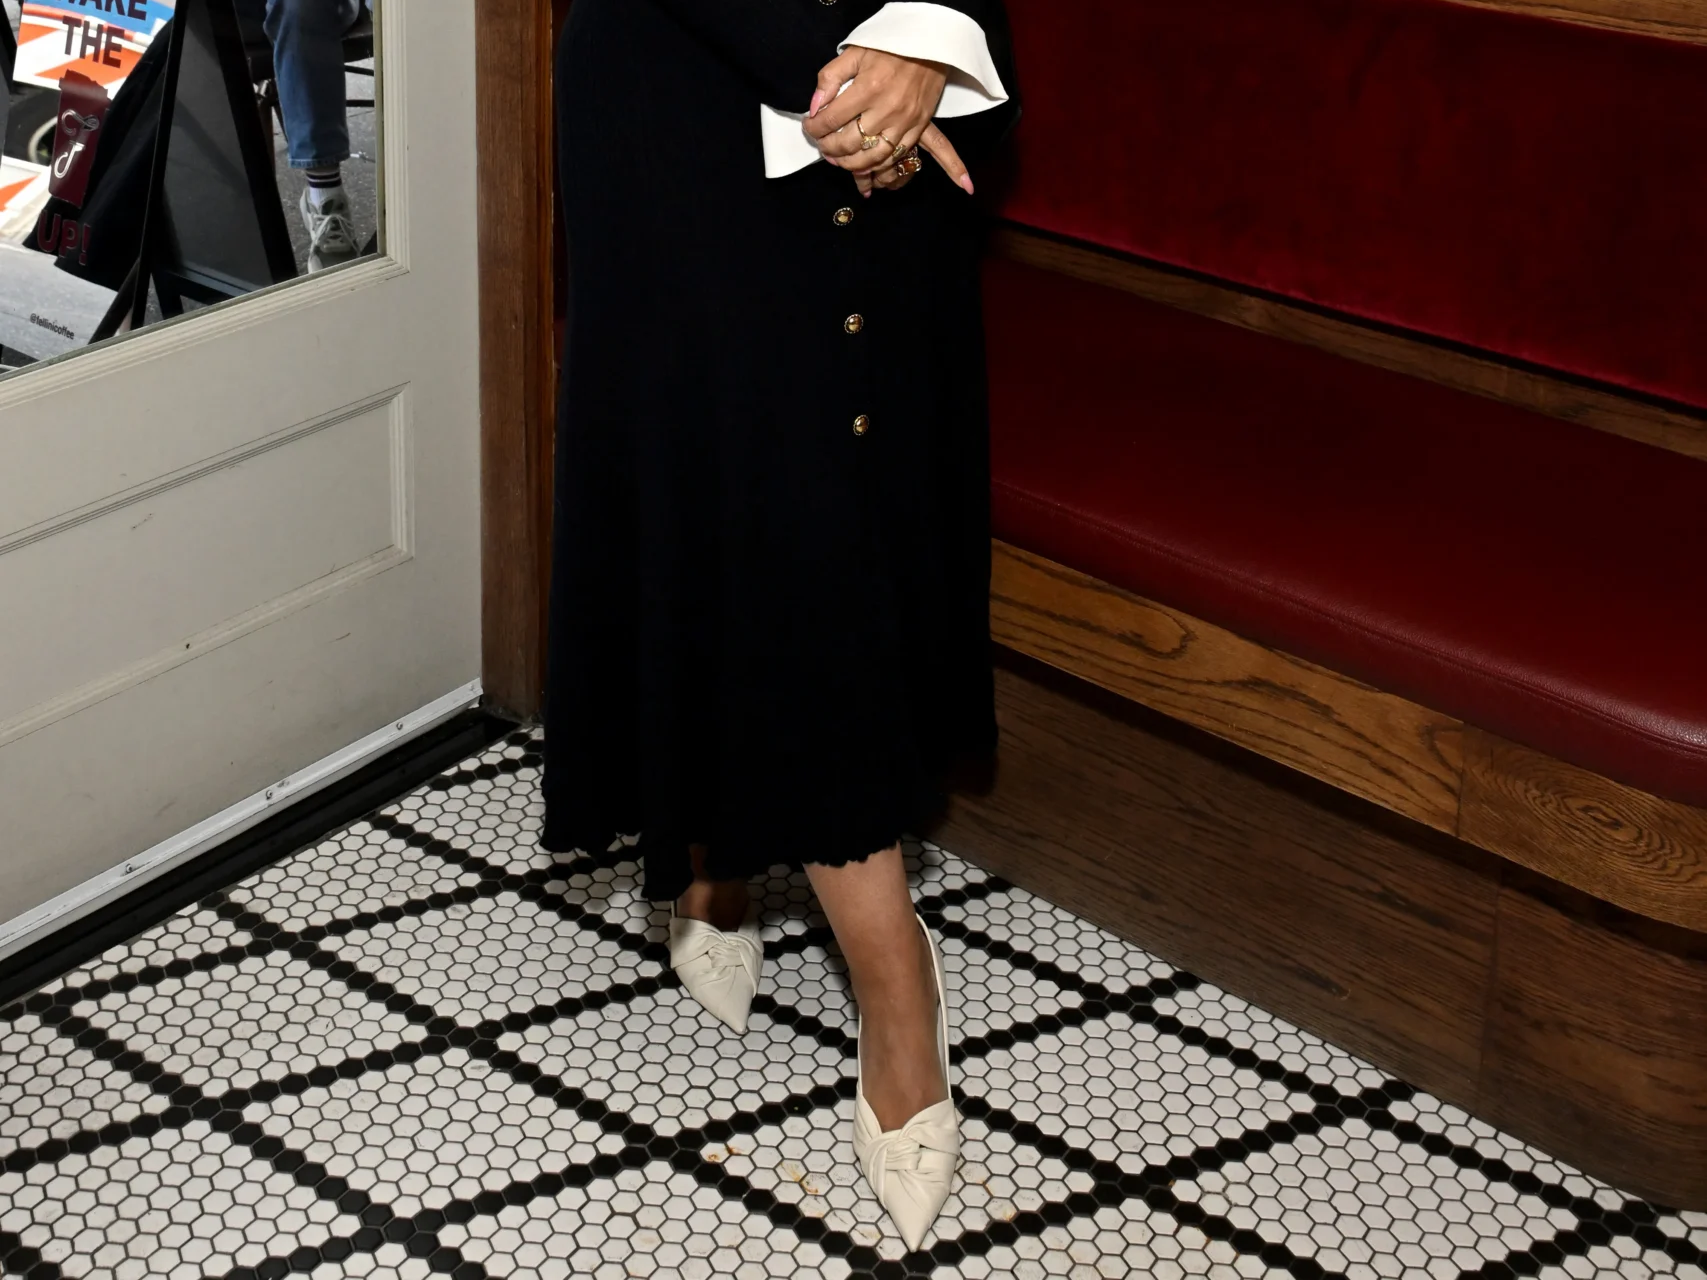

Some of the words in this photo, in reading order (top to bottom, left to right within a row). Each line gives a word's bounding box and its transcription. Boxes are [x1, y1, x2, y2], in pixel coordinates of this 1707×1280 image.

[62, 15, 126, 69] THE
[36, 208, 92, 266] UP!
[29, 312, 76, 340] @fellinicoffee
